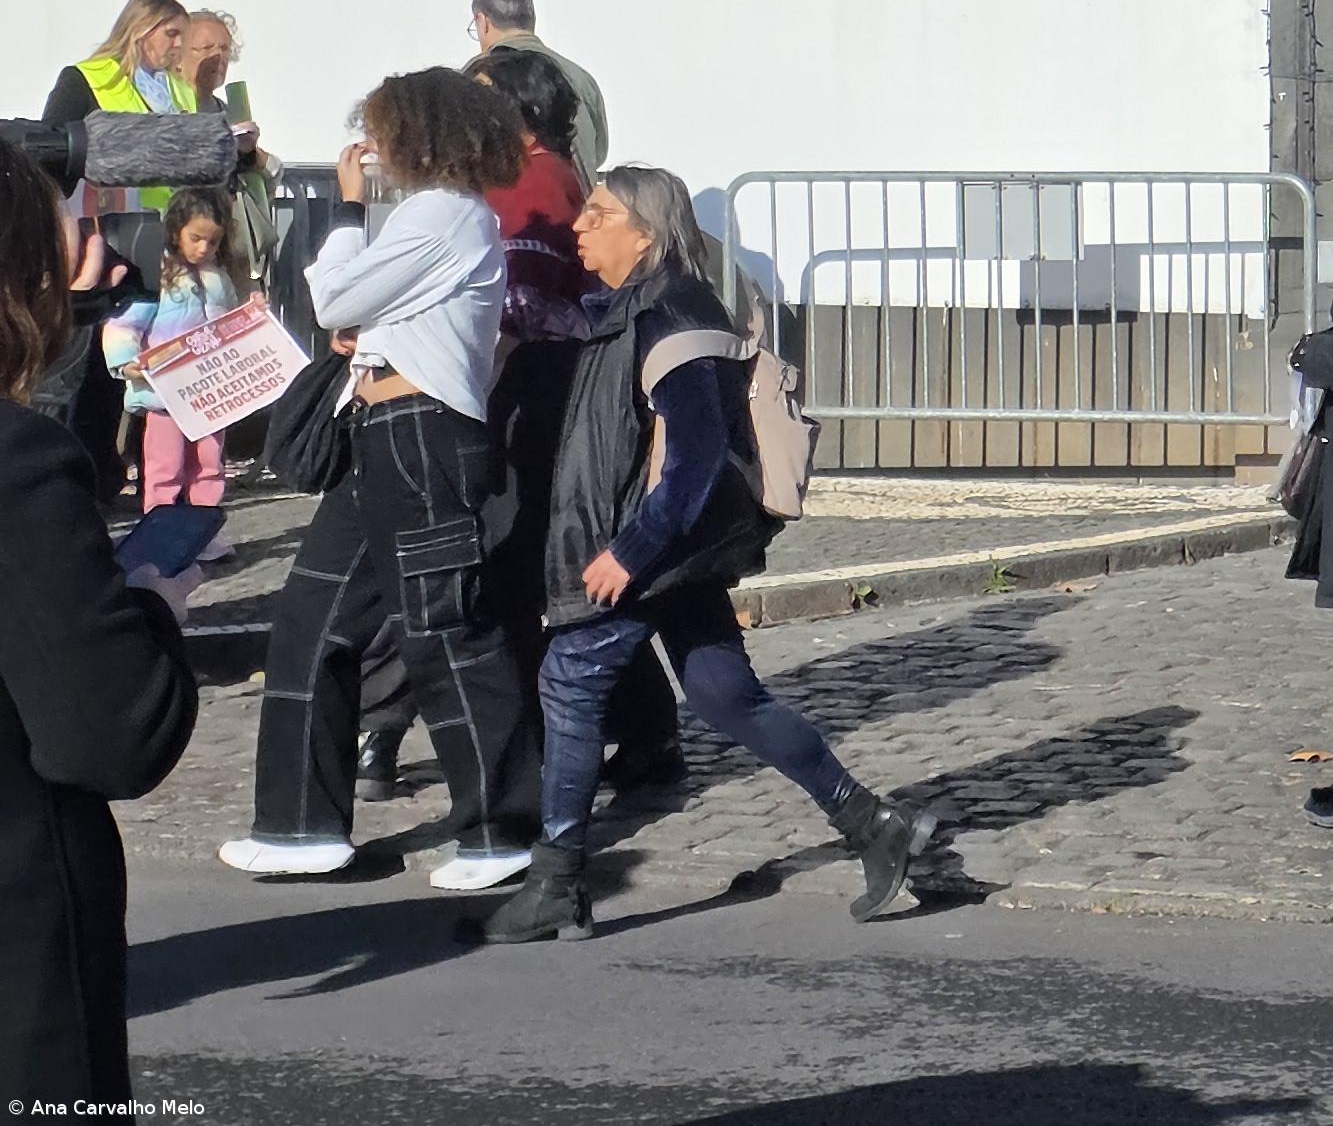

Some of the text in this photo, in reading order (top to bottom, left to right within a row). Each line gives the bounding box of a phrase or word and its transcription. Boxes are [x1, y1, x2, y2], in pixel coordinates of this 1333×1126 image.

[177, 344, 278, 401] PACOTE LABORAL
[190, 358, 283, 413] NÃO ACEITAMOS
[195, 348, 240, 376] NÃO AO
[203, 373, 287, 422] RETROCESSOS
